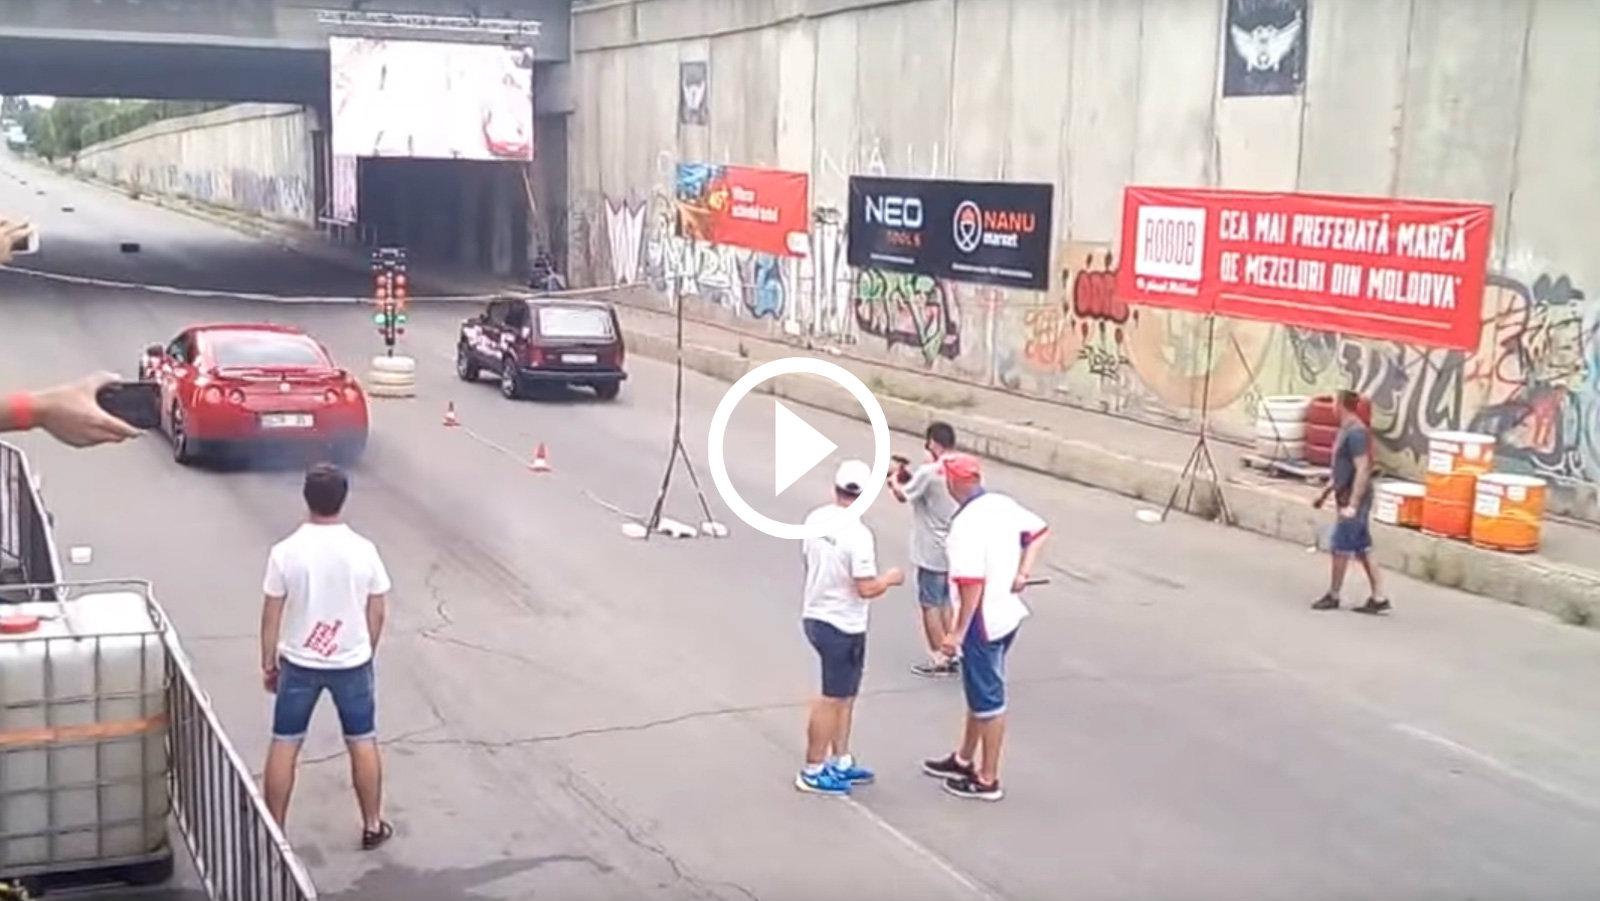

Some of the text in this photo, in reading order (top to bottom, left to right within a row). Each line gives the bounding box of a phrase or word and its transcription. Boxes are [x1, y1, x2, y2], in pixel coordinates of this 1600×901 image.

[865, 195, 923, 228] NEO
[984, 211, 1035, 233] NANU
[1220, 209, 1249, 241] CEA
[1255, 211, 1287, 244] MAI
[1220, 251, 1241, 283] DE
[1244, 253, 1327, 292] MEZELURI
[1330, 263, 1363, 298] DIN
